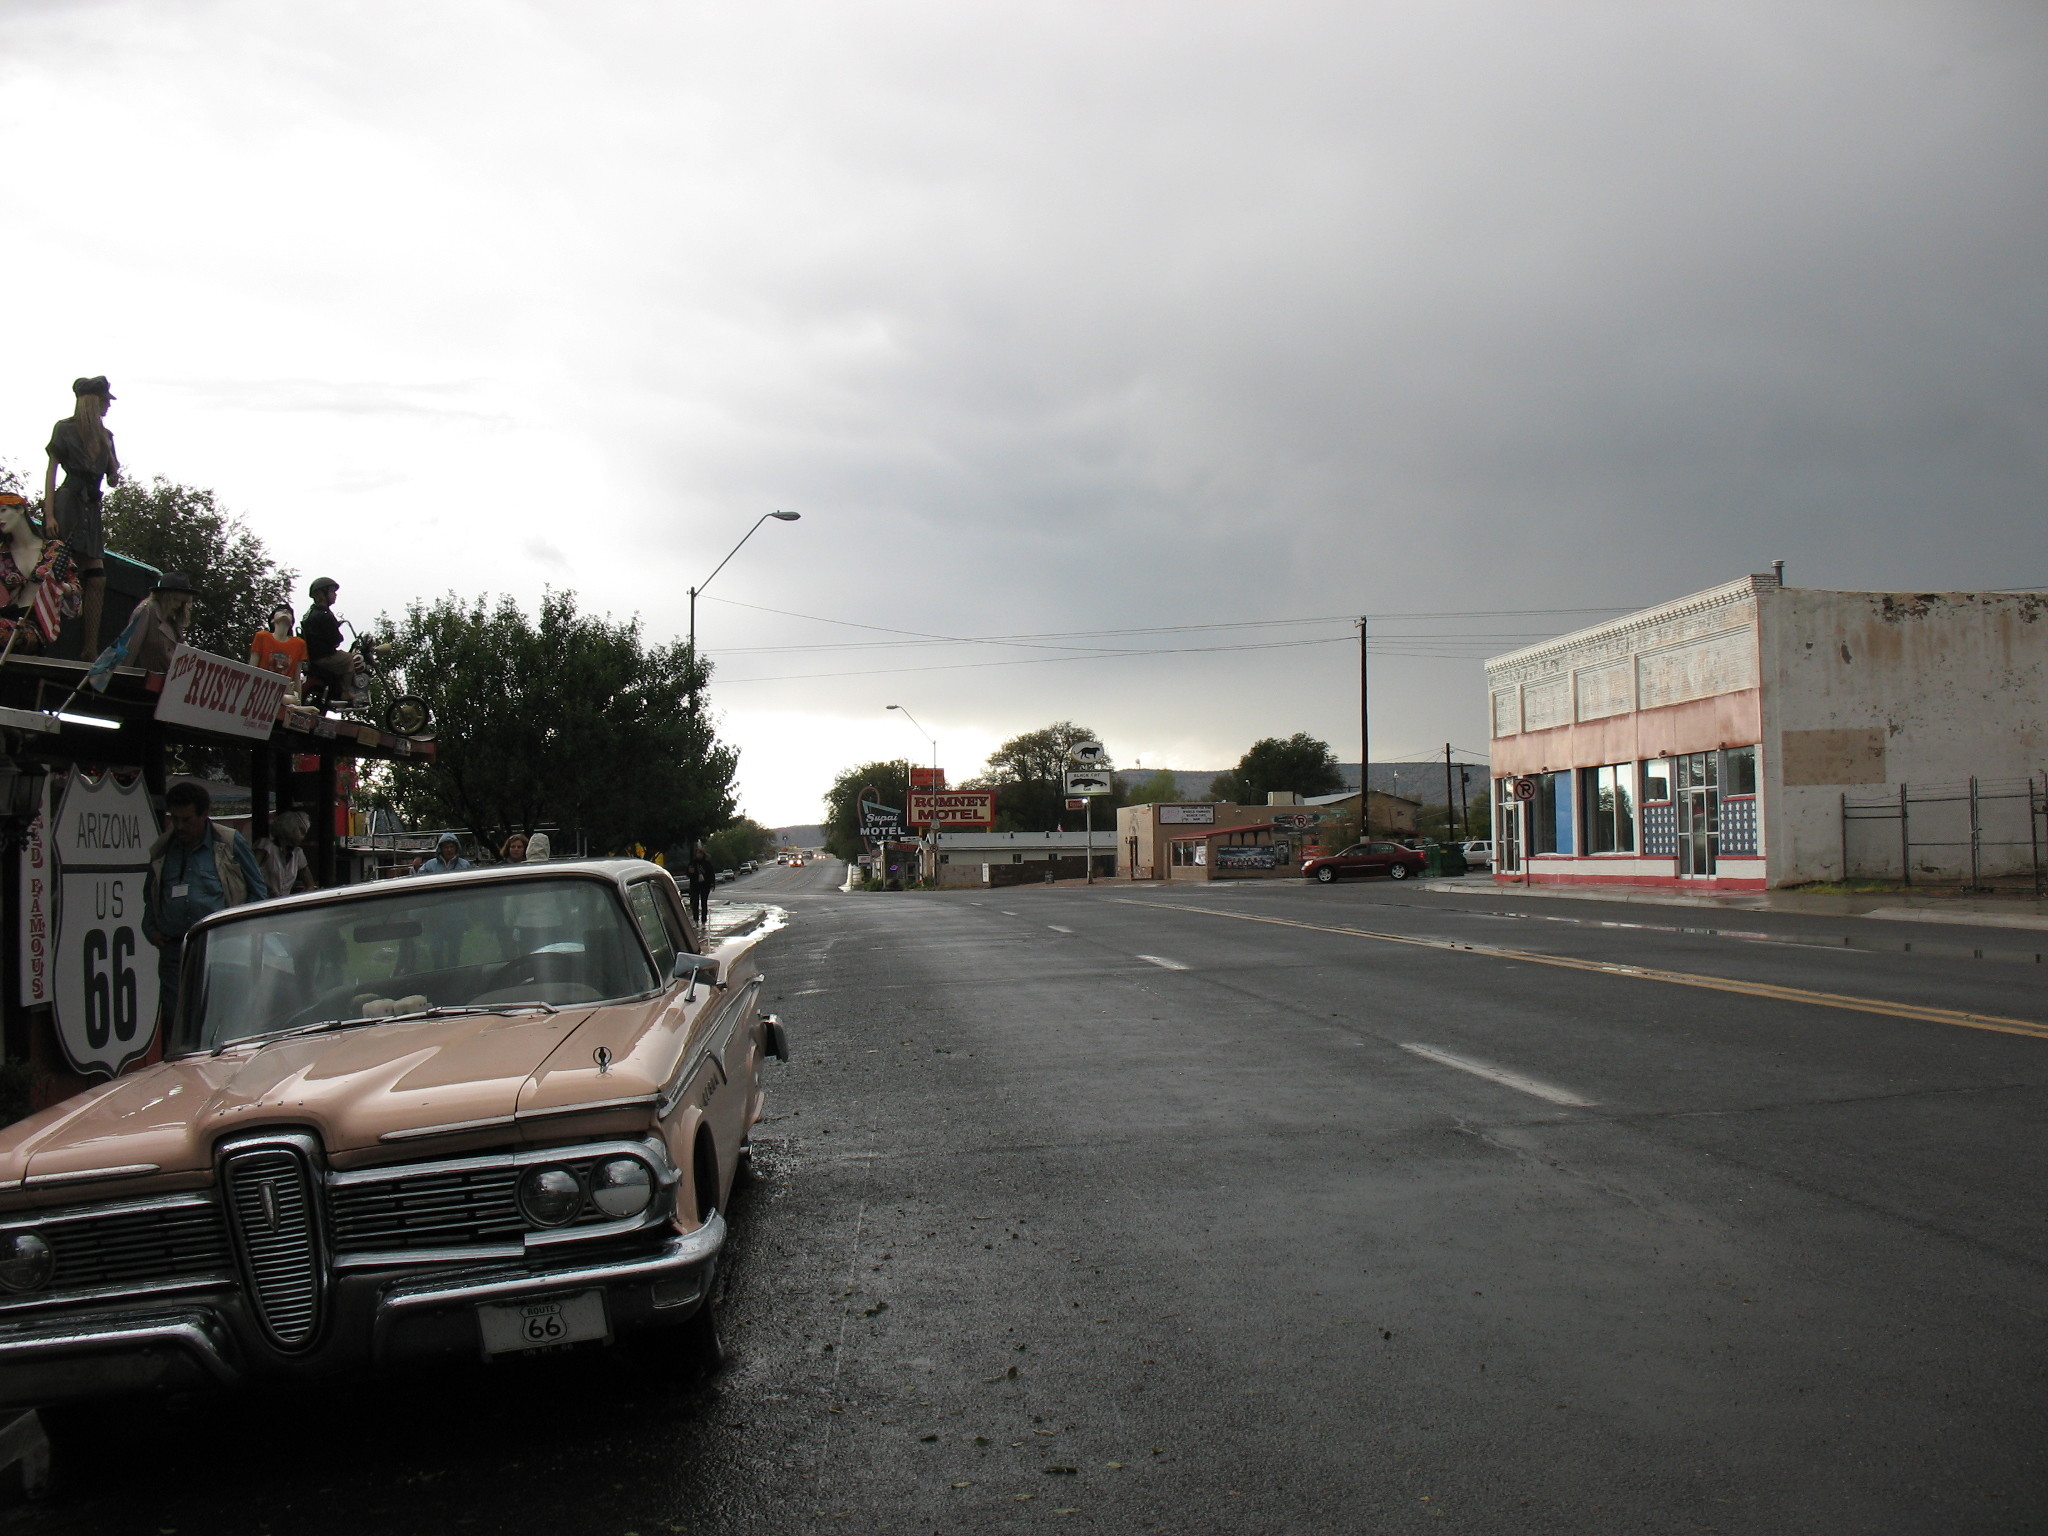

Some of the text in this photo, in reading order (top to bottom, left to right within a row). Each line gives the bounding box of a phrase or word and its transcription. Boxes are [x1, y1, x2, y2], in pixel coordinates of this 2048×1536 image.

[171, 653, 287, 722] The RUSTY BOLT
[914, 797, 989, 807] ROMNEY
[866, 813, 898, 825] Supai
[918, 809, 984, 820] MOTEL
[76, 812, 141, 849] ARIZONA
[860, 827, 905, 835] MOTEL
[95, 880, 124, 920] US
[30, 878, 45, 999] FAMOUS
[83, 925, 137, 1050] 66
[527, 1305, 556, 1316] ROUTE
[528, 1316, 561, 1338] 66
